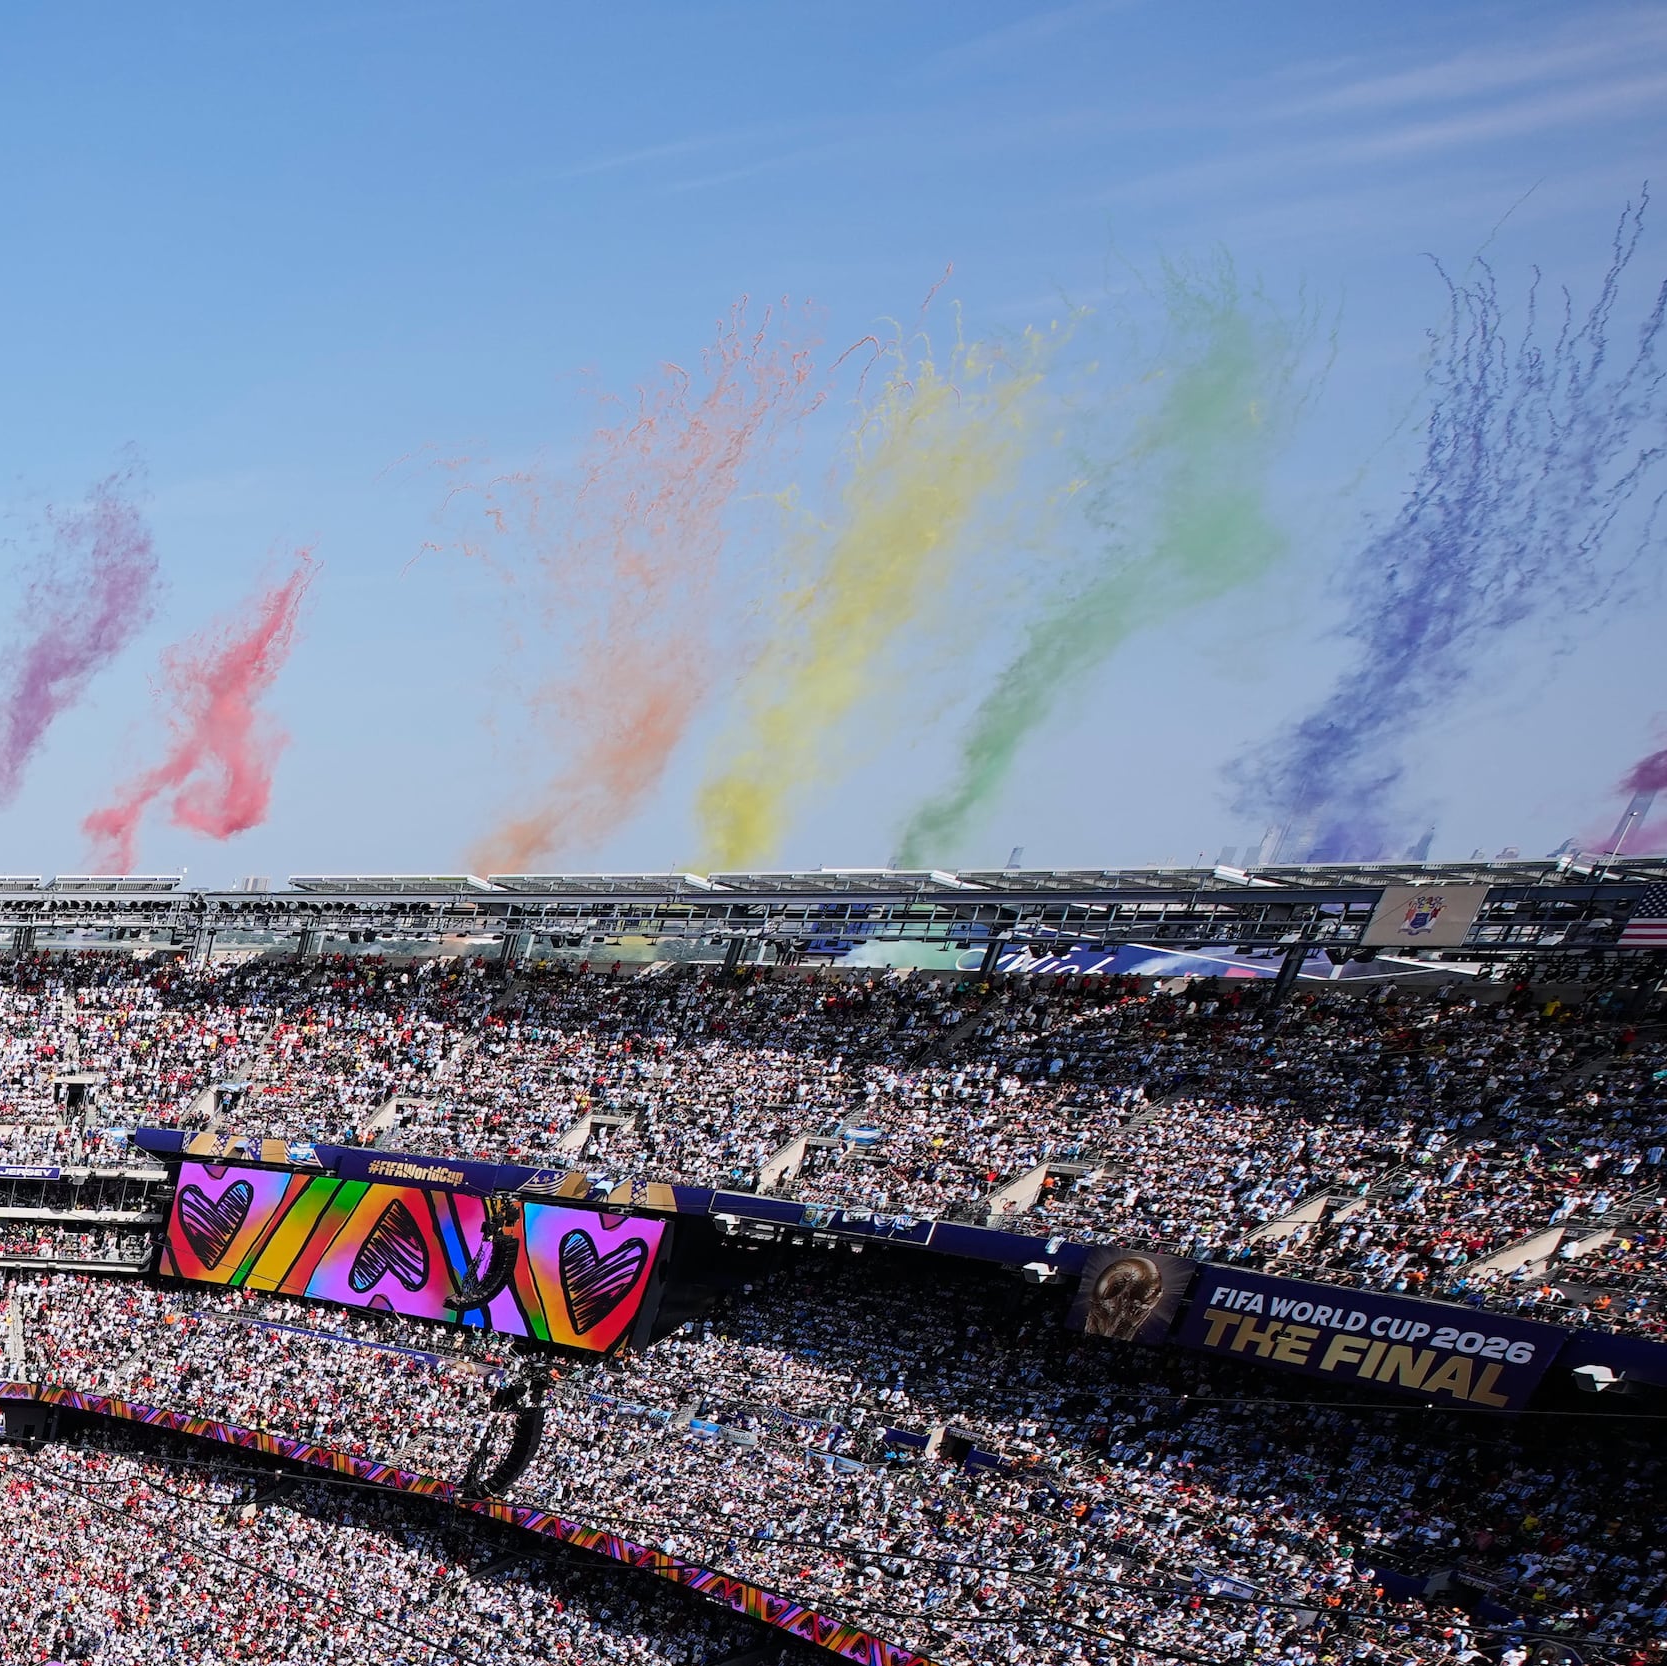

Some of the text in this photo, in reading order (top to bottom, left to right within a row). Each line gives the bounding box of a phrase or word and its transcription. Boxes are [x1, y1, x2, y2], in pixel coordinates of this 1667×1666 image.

[0, 1167, 53, 1177] JERSEY
[368, 1160, 464, 1187] #FIFAWorldCup
[1210, 1286, 1535, 1364] FIFA WORLD CUP 2026
[1203, 1308, 1509, 1408] THE FINAL
